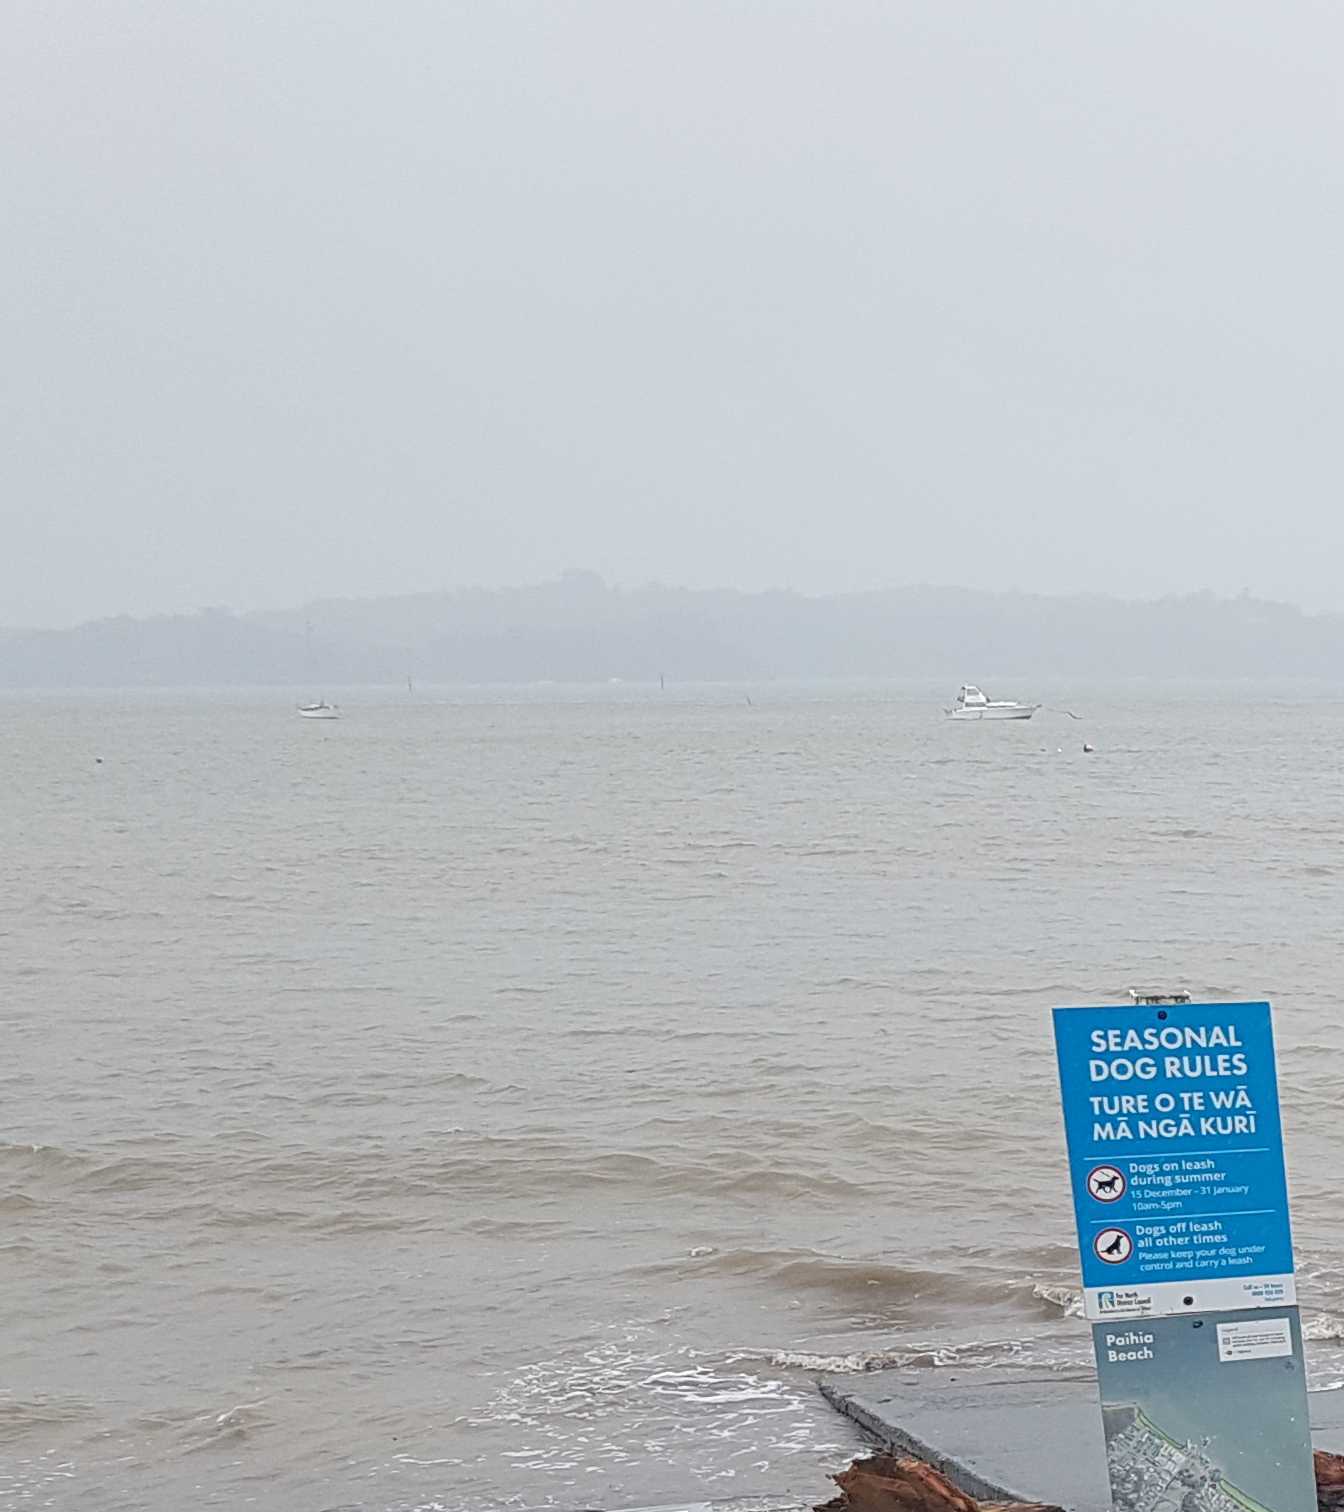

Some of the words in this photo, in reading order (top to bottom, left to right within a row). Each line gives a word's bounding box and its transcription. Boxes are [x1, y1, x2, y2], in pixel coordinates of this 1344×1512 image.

[1090, 1025, 1242, 1052] SEASONAL
[1088, 1056, 1158, 1082] DOG
[1164, 1053, 1248, 1079] RULES
[1089, 1095, 1150, 1116] TURE
[1154, 1093, 1176, 1112] O
[1179, 1092, 1205, 1111] TE
[1209, 1085, 1252, 1110] WĀ
[1093, 1117, 1134, 1142] MĀ
[1138, 1114, 1196, 1139] NGĀ
[1200, 1110, 1257, 1136] KURĪ
[1129, 1162, 1160, 1174] Dogs
[1162, 1162, 1179, 1172] on
[1182, 1159, 1215, 1170] leash
[1130, 1175, 1172, 1187] during
[1174, 1172, 1226, 1184] summer
[1131, 1190, 1142, 1199] 15
[1144, 1188, 1192, 1198] December
[1200, 1186, 1211, 1195] 31
[1213, 1185, 1249, 1196] January
[1136, 1225, 1166, 1236] Dogs
[1169, 1222, 1186, 1233] off
[1189, 1220, 1222, 1232] leash
[1138, 1237, 1152, 1248] all
[1156, 1236, 1189, 1247] other
[1192, 1234, 1228, 1244] times
[1138, 1252, 1169, 1260] Please
[1170, 1250, 1194, 1261] keep
[1195, 1249, 1216, 1259] your
[1218, 1246, 1236, 1257] dog
[1238, 1246, 1266, 1254] under
[1140, 1261, 1172, 1271] control
[1175, 1260, 1193, 1269] and
[1195, 1258, 1218, 1270] carry
[1220, 1258, 1227, 1266] a
[1228, 1256, 1253, 1265] leash
[1106, 1331, 1154, 1346] Paihia
[1108, 1346, 1154, 1362] Beach
